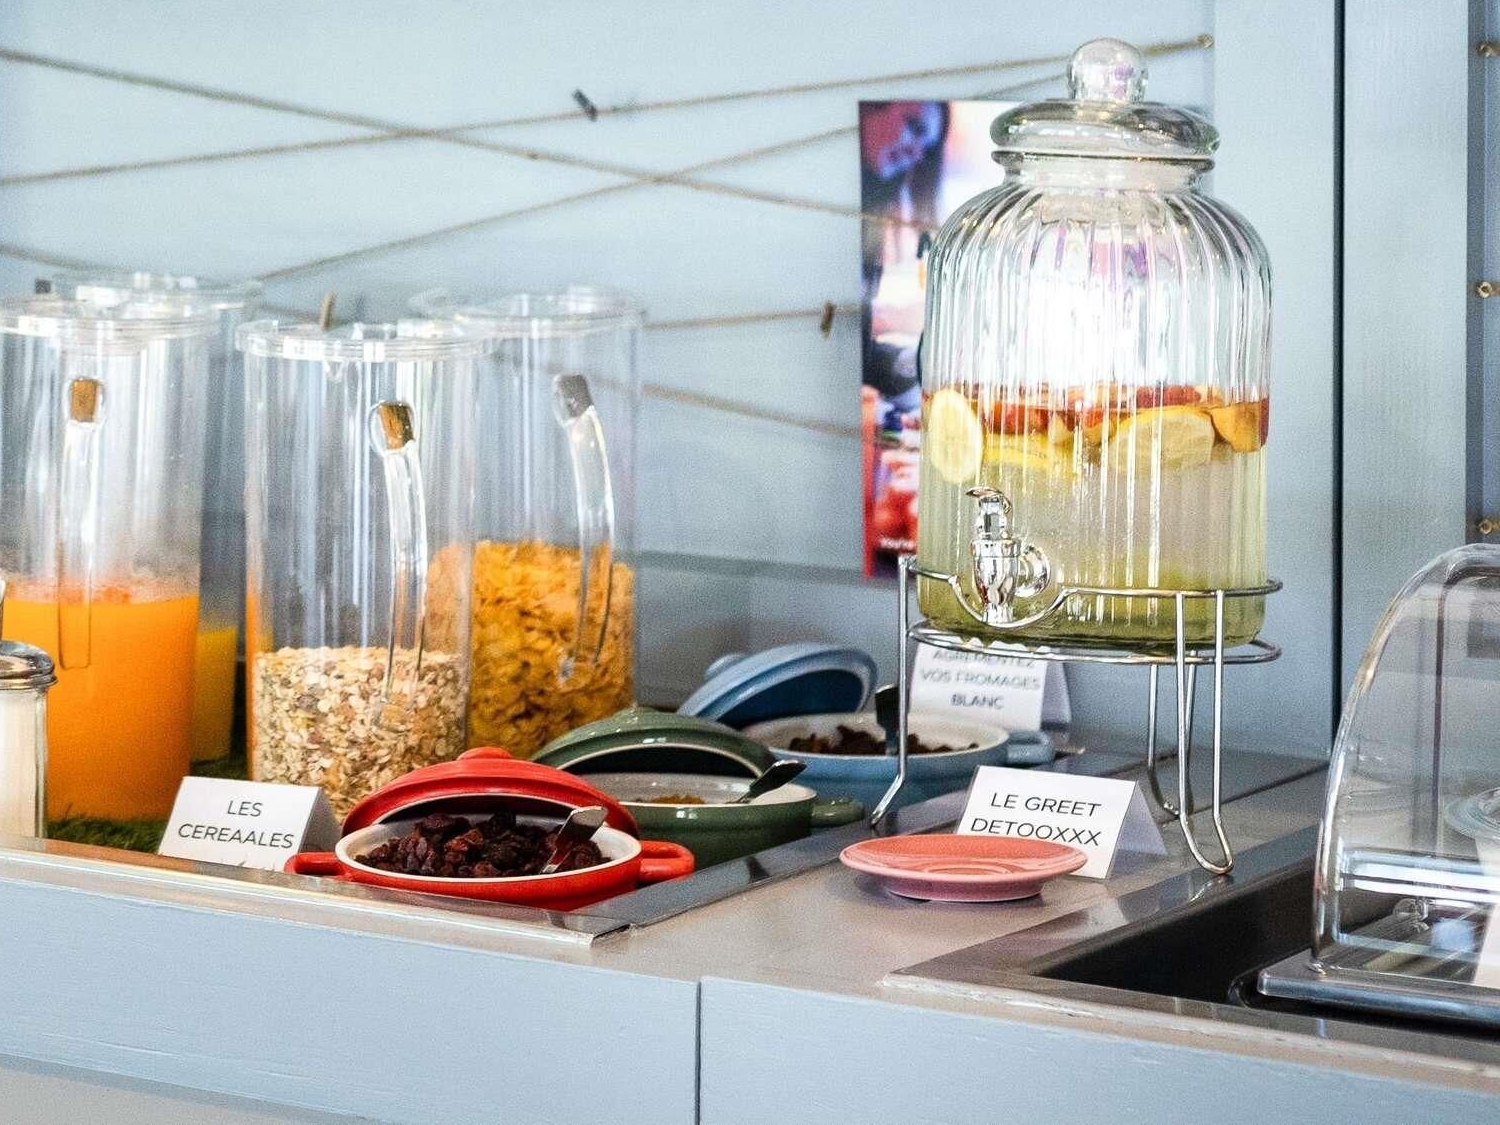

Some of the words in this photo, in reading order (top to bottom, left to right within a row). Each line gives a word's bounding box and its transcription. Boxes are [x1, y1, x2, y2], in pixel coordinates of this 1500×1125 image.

[921, 668, 952, 684] VOS
[956, 670, 1043, 691] FROMAGES
[949, 693, 1006, 710] BLANC
[226, 800, 264, 819] LES
[990, 792, 1019, 809] LE
[1024, 796, 1102, 817] GREET
[177, 823, 295, 850] CEREAALES
[970, 818, 1102, 847] DETOOXXX
